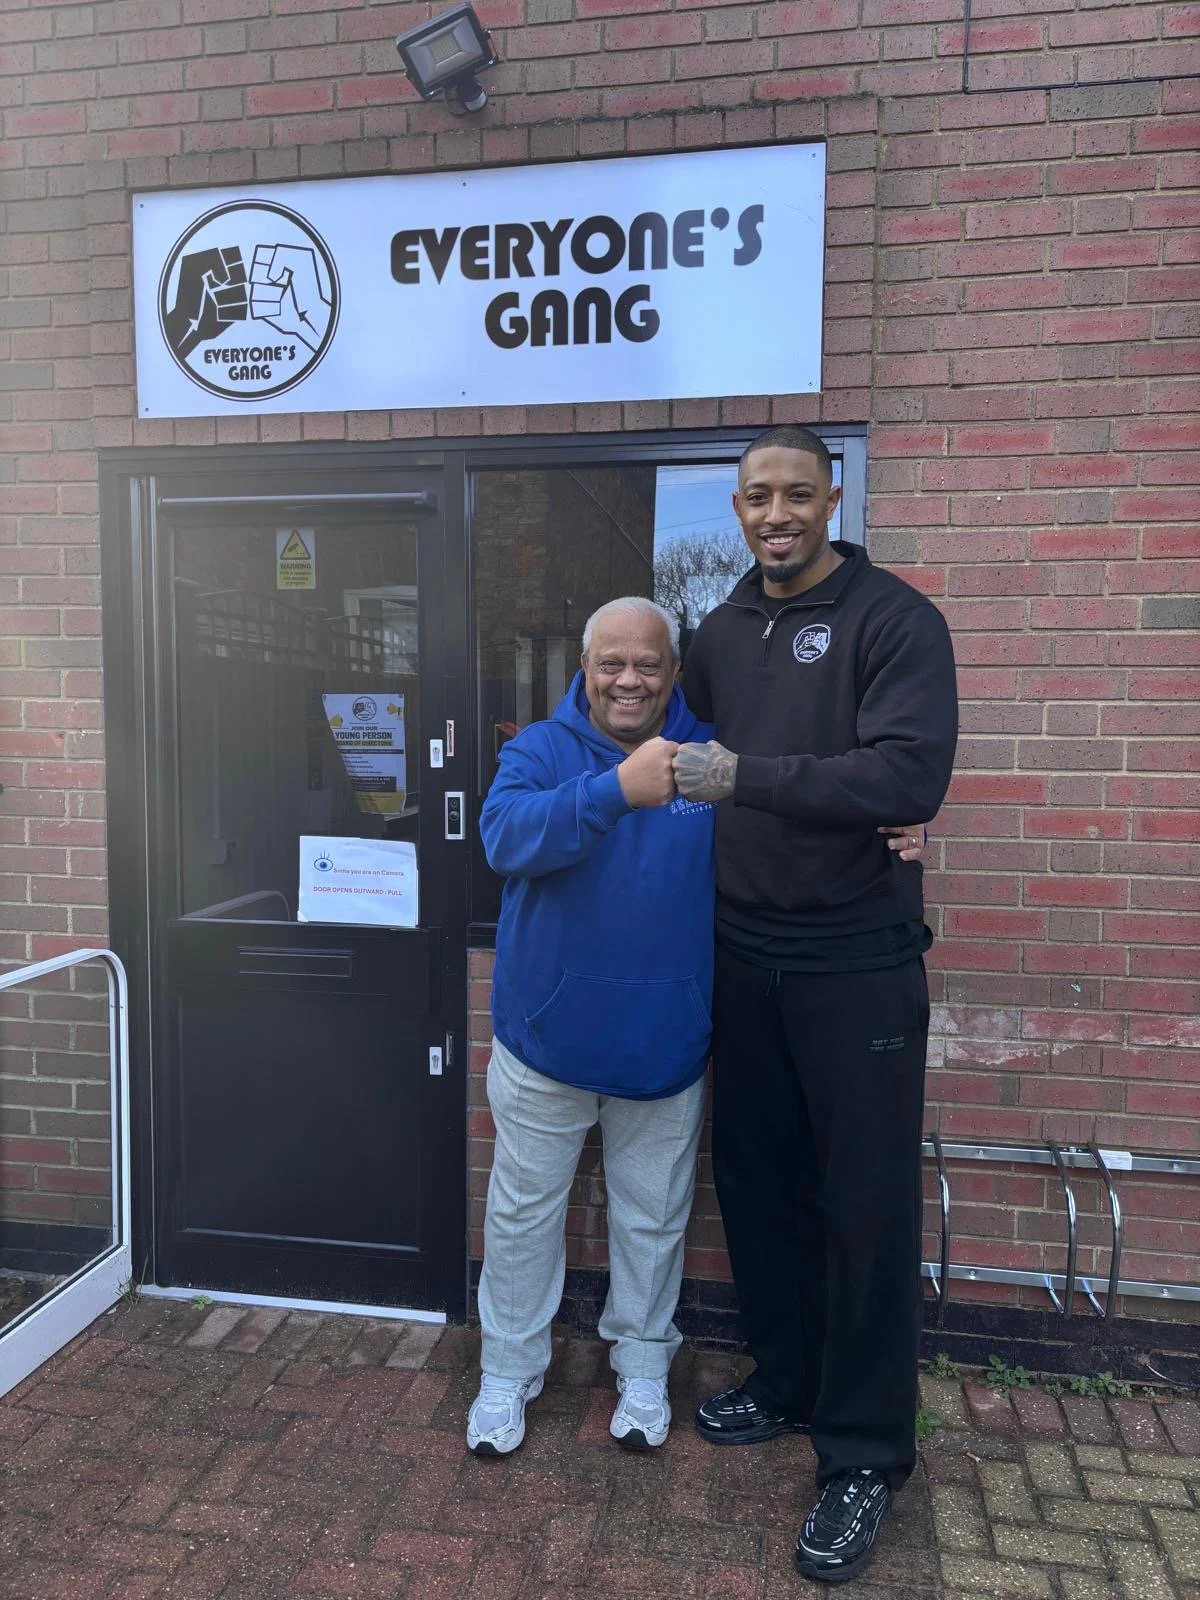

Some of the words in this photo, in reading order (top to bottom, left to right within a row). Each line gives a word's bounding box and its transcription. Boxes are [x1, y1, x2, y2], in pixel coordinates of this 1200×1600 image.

[390, 204, 765, 285] EVERYONE'S
[484, 284, 661, 349] GANG
[204, 345, 296, 364] EVERYONE'S
[228, 364, 272, 381] GANG
[335, 731, 361, 740] YOUNG
[362, 731, 393, 740] PERSON
[381, 869, 404, 877] Camera
[332, 886, 353, 894] OPENS
[353, 887, 384, 895] OUTWARD
[387, 889, 403, 897] PULL
